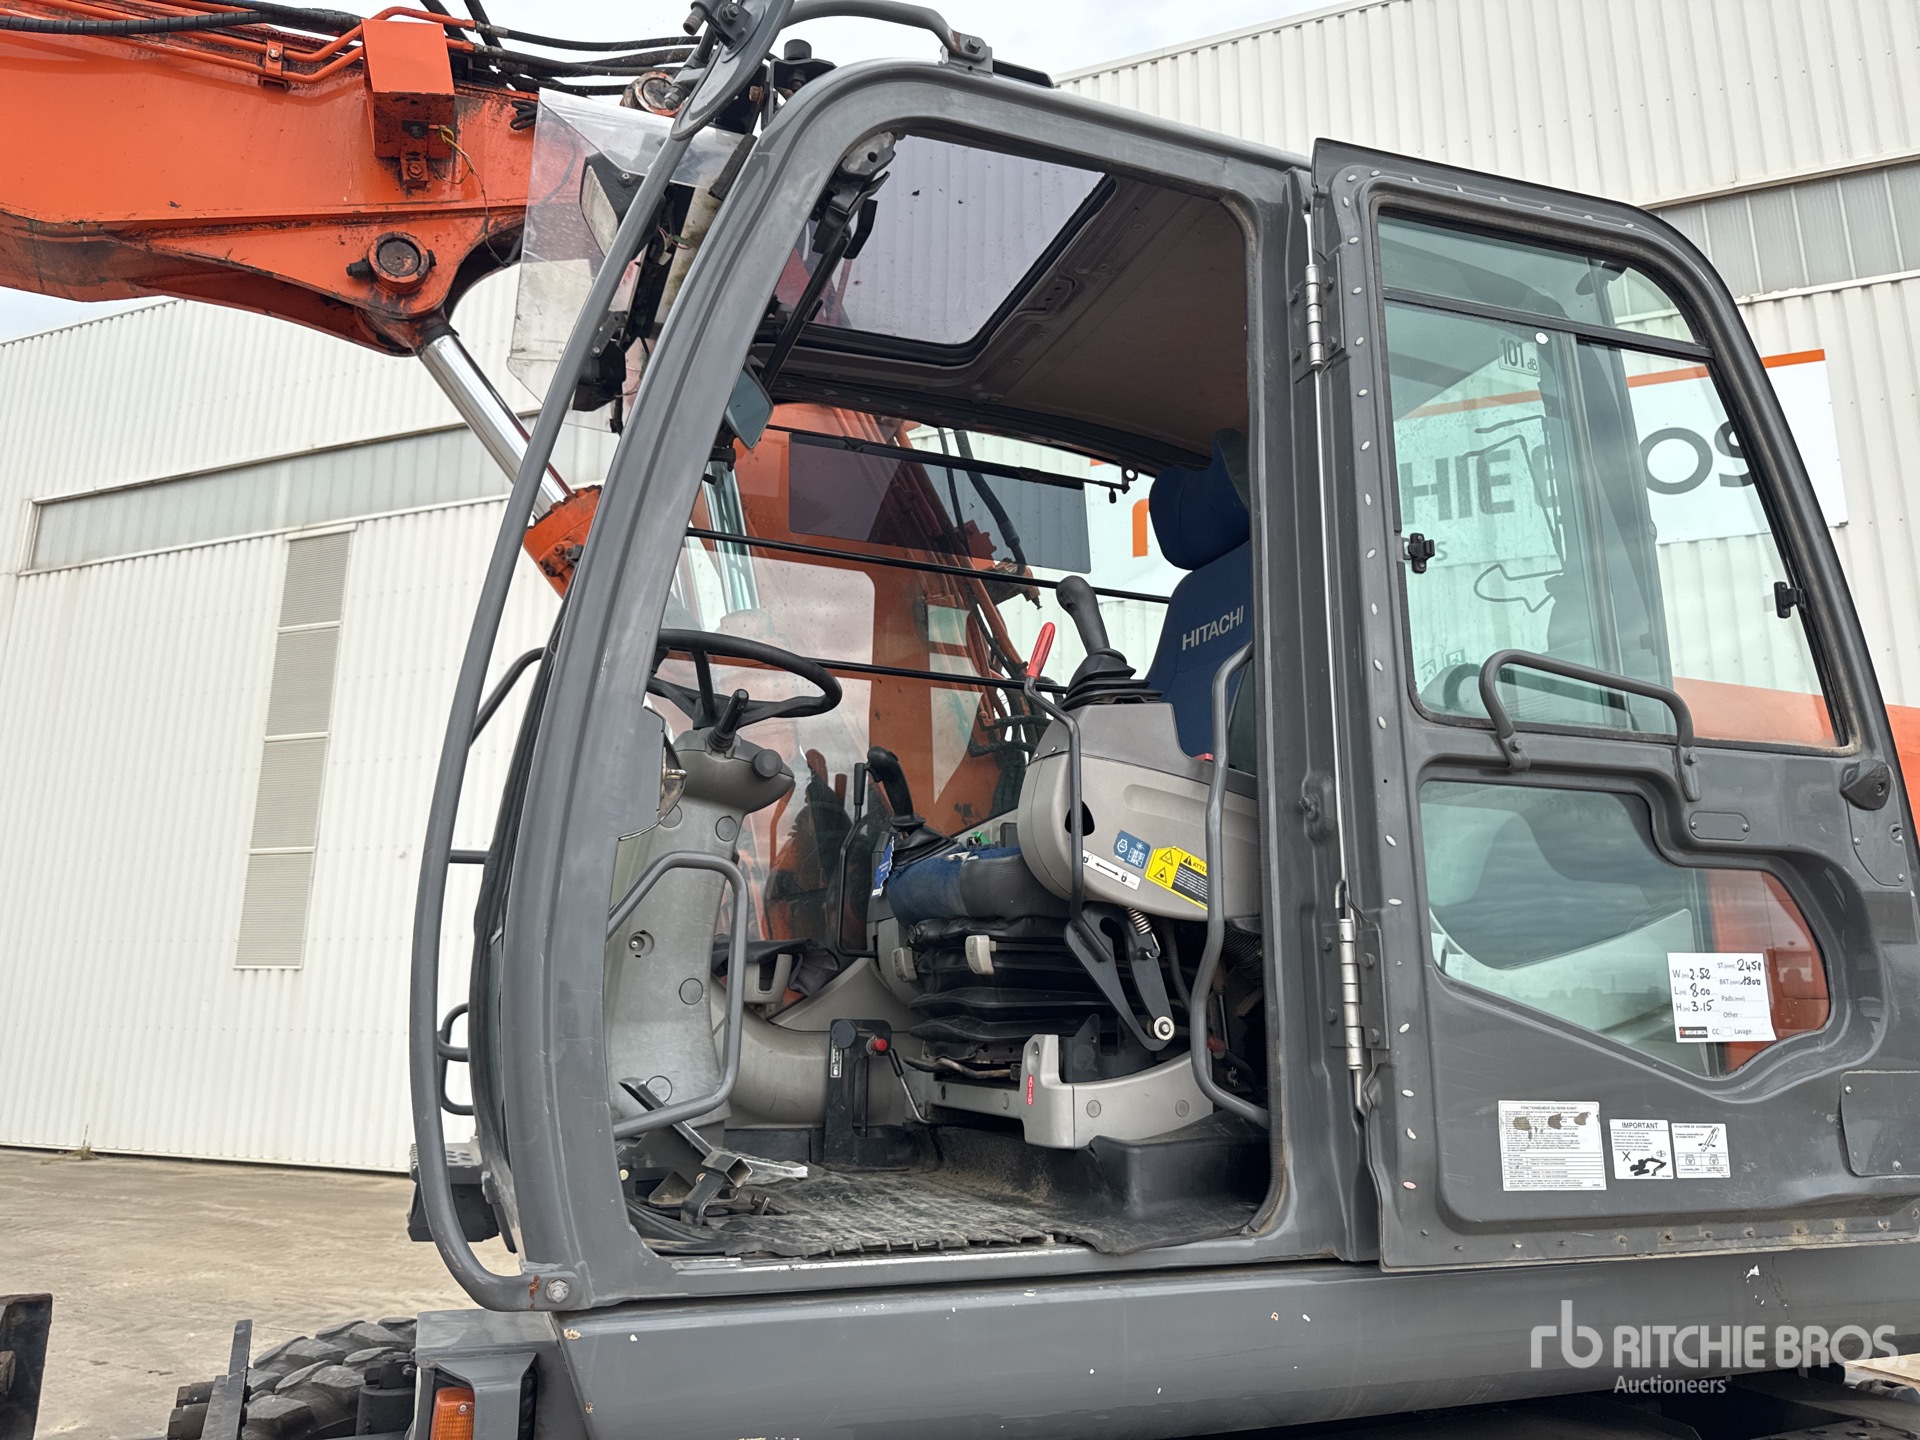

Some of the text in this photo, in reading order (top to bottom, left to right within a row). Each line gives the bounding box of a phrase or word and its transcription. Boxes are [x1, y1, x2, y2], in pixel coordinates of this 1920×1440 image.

[1500, 337, 1538, 371] 101 dB
[1182, 604, 1245, 652] HITACHI
[1192, 861, 1207, 873] ATTE
[1689, 967, 1711, 980] 2.52
[1740, 975, 1761, 986] 1800
[1691, 998, 1715, 1012] 3.15
[1621, 1121, 1659, 1129] IMPORTANT
